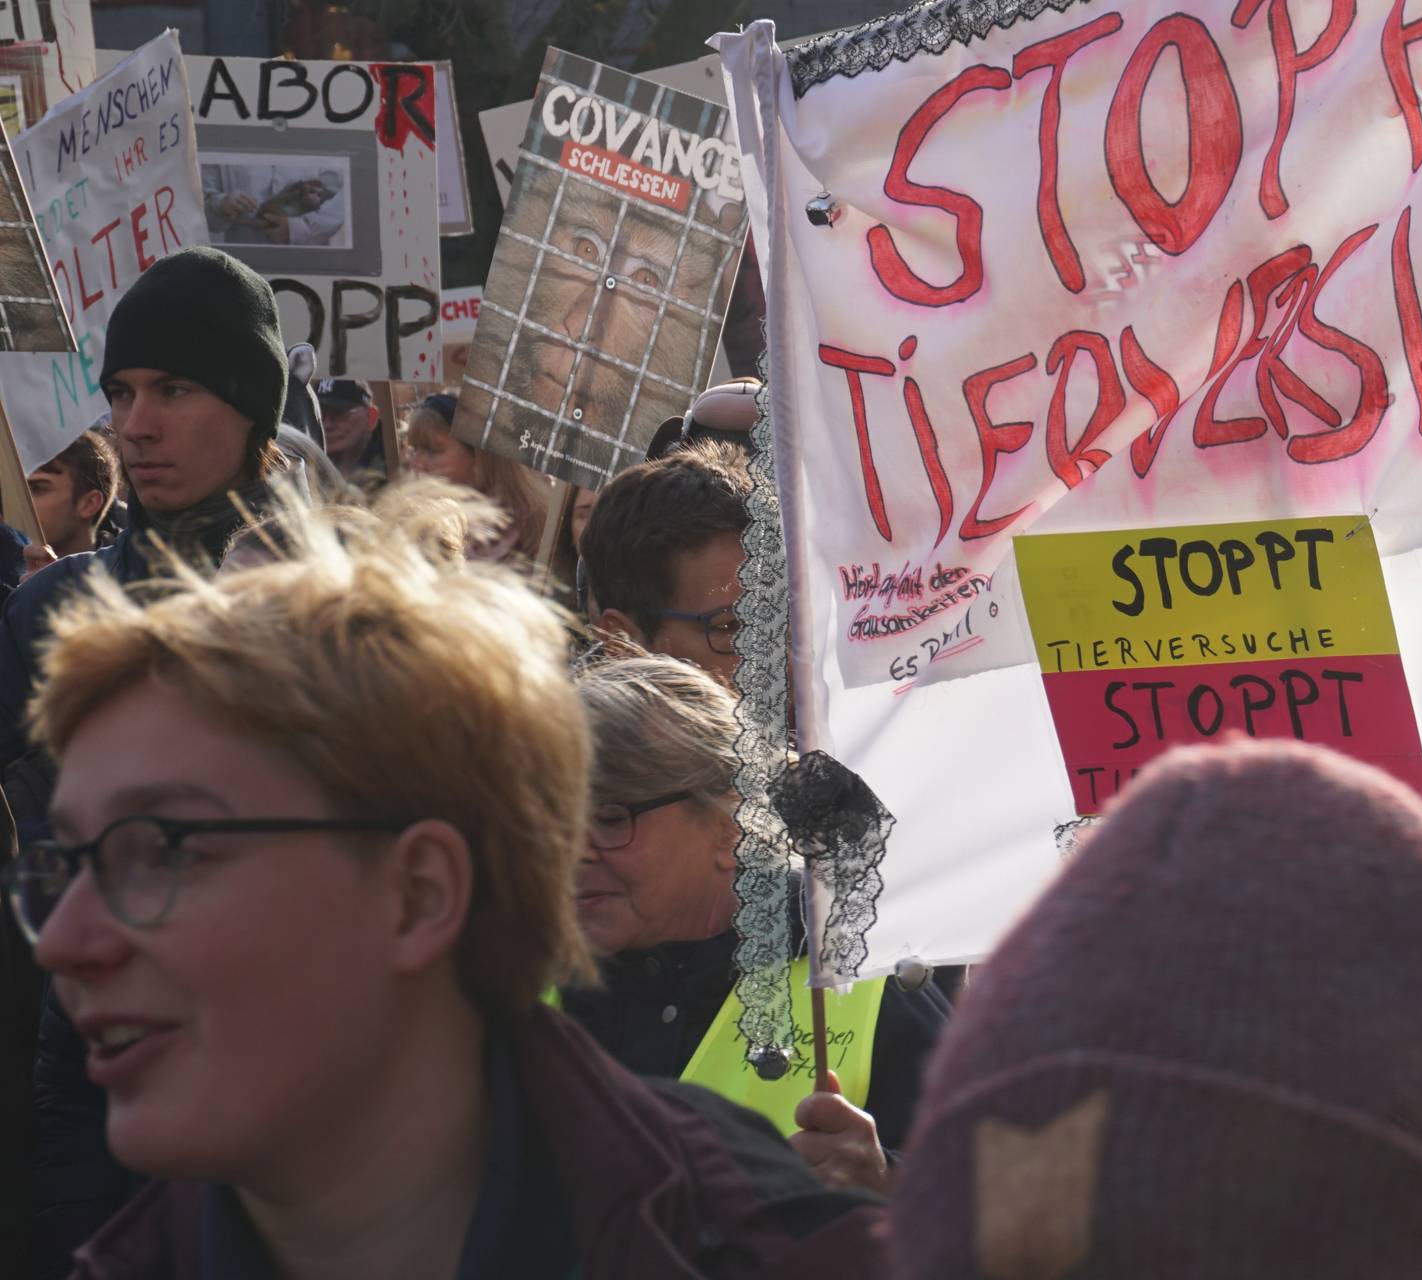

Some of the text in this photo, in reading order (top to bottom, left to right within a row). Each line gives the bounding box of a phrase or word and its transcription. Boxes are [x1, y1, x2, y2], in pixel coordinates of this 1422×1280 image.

[57, 57, 174, 174] MENSCHEN
[192, 58, 436, 142] ABOR
[114, 136, 149, 183] IHR
[159, 112, 180, 154] ES
[542, 85, 745, 201] COVANCE
[568, 147, 680, 202] SCHLIESSEN!
[52, 324, 107, 428] NE
[928, 561, 972, 593] den
[1112, 528, 1334, 617] STOPPT
[889, 655, 918, 681] ES
[1047, 628, 1335, 673] TIERVERSUCHE
[1104, 669, 1364, 750] STOPPT
[1077, 766, 1138, 806] TI
